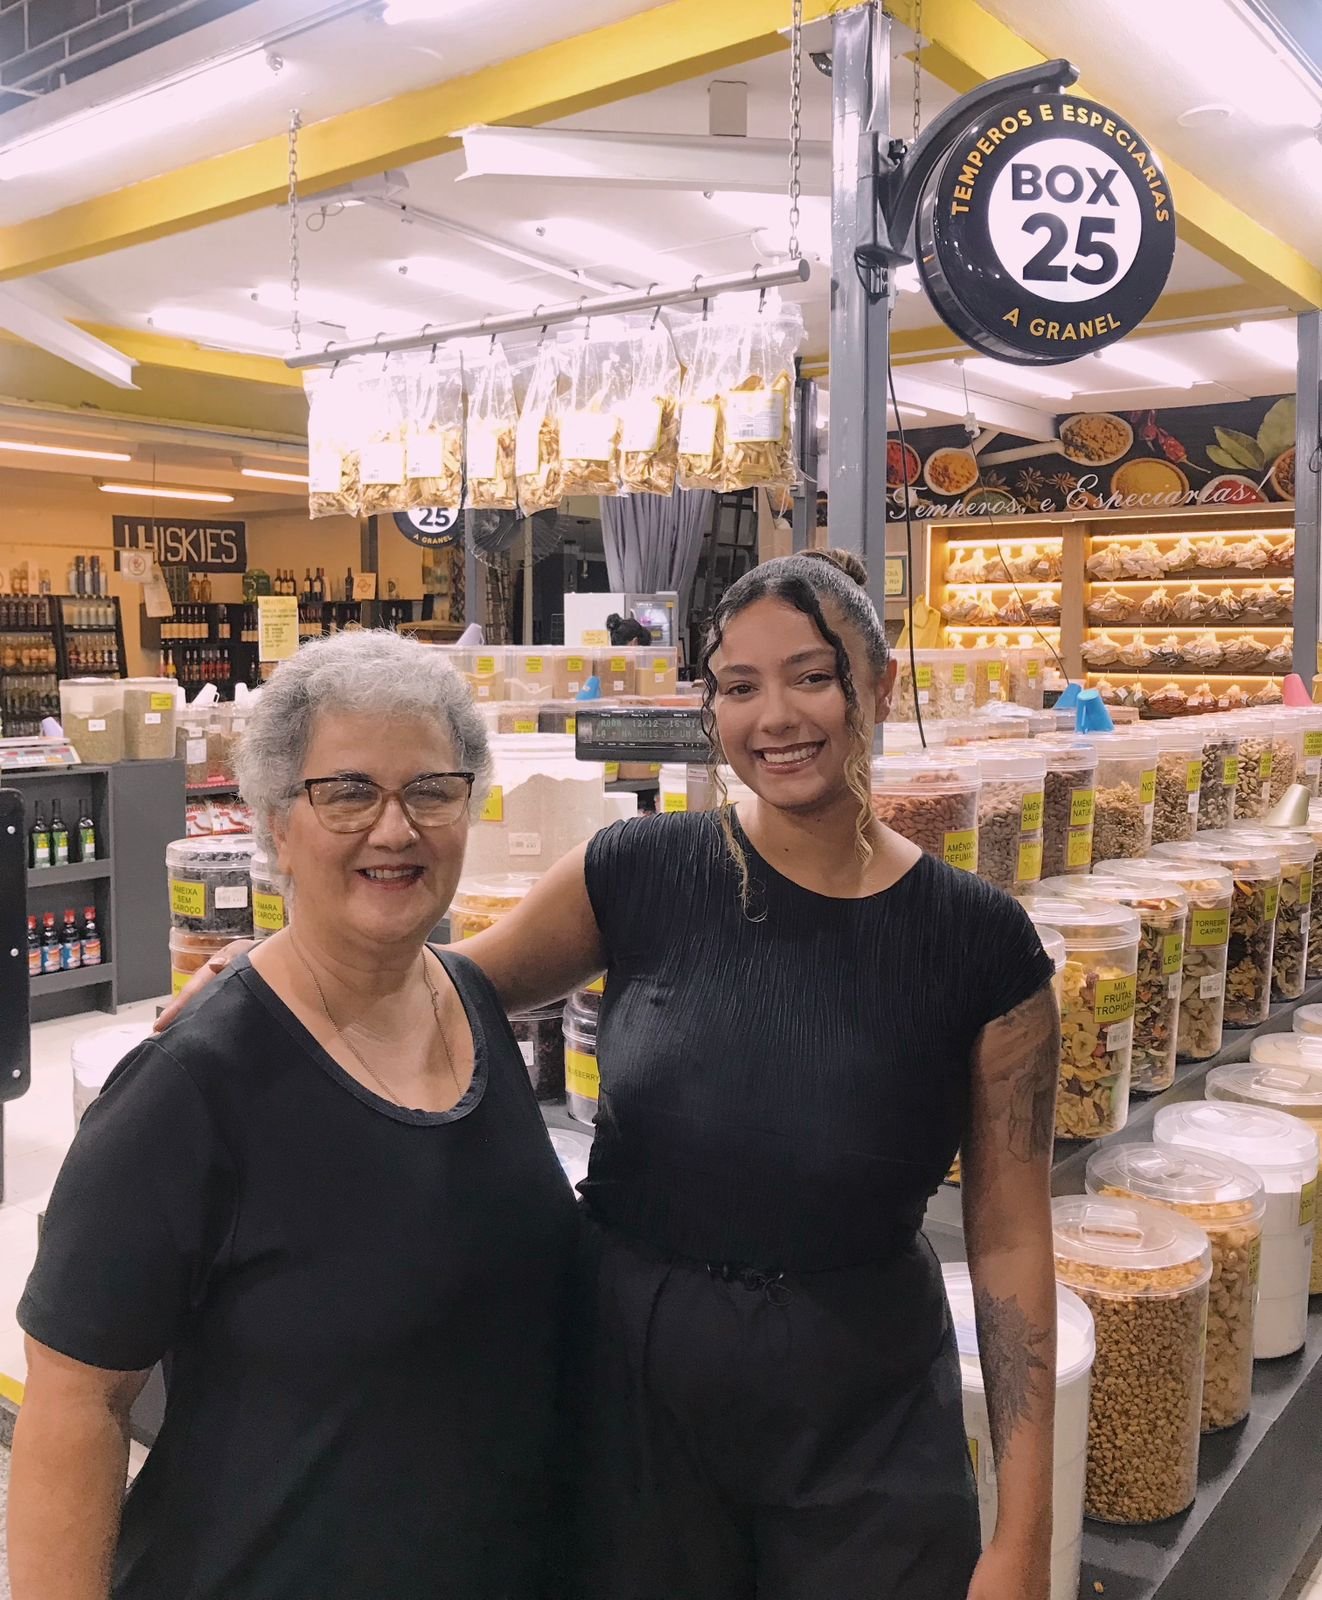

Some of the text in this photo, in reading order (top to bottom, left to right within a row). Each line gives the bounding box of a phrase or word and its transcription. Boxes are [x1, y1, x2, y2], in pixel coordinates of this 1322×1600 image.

[951, 103, 1170, 223] TEMPEROS E ESPECIARIAS
[1011, 163, 1121, 207] BOX
[1021, 212, 1119, 286] 25
[1003, 307, 1122, 341] A GRANEL
[418, 507, 451, 528] 25
[421, 535, 454, 545] GRANEL
[1103, 989, 1132, 1004] FRUTAS
[1113, 981, 1128, 991] MIX
